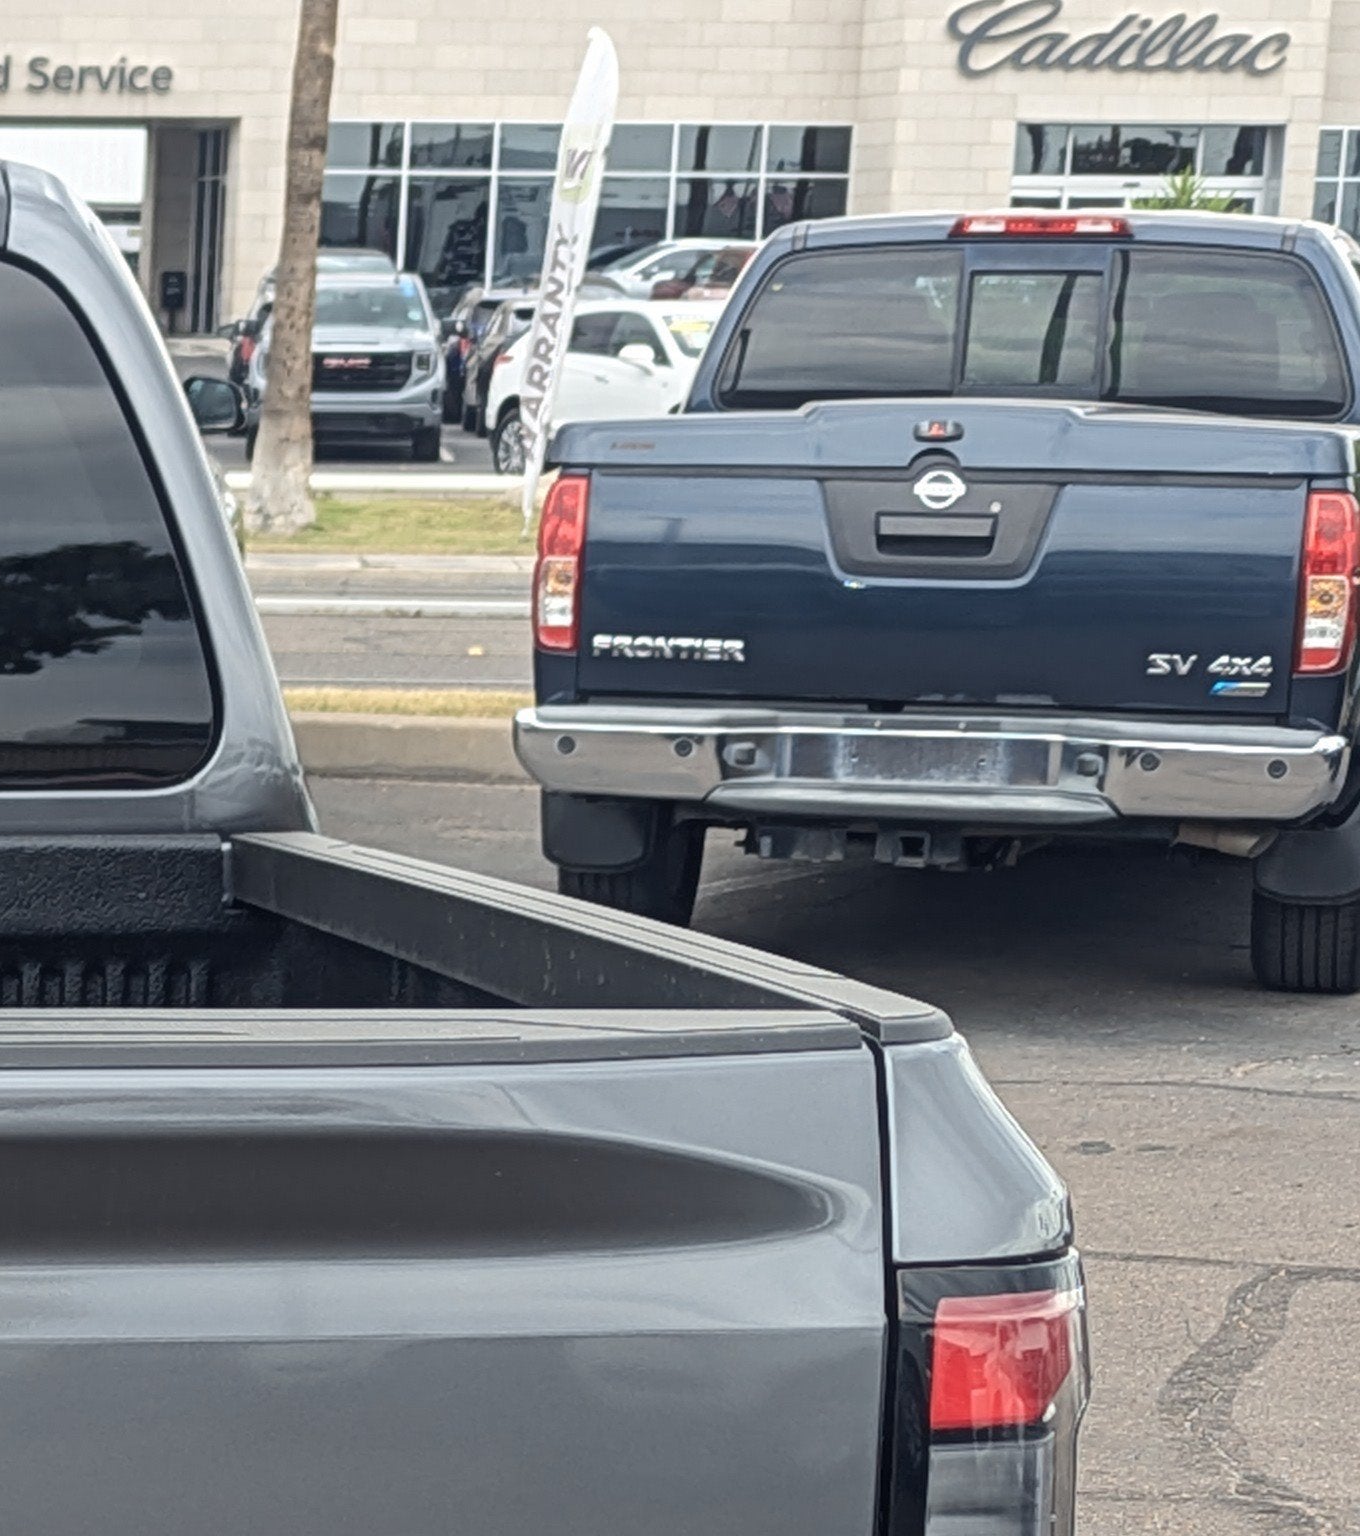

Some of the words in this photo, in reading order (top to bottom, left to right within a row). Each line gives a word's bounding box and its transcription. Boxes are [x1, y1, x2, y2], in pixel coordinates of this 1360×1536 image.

[946, 0, 1292, 78] Cadillac
[26, 56, 174, 93] Service
[592, 634, 746, 662] FRONTIER
[1146, 653, 1198, 676] SV
